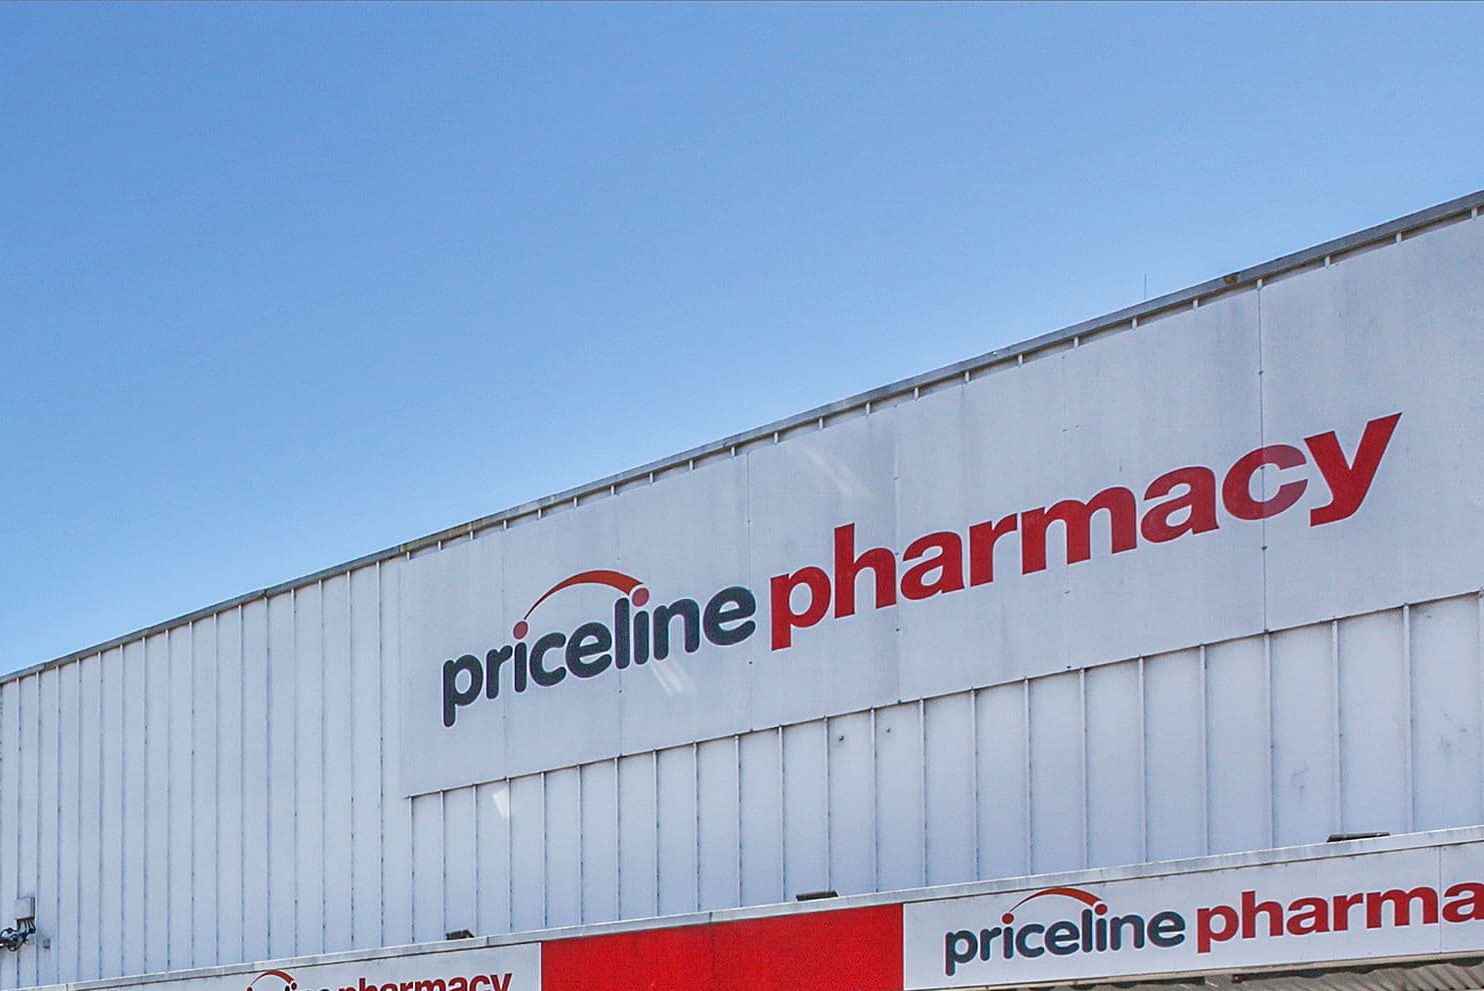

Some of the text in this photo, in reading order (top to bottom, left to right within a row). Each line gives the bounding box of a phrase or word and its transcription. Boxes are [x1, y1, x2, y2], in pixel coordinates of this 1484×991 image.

[442, 411, 1402, 726] priceline pharmacy
[944, 882, 1484, 976] priceline pharma
